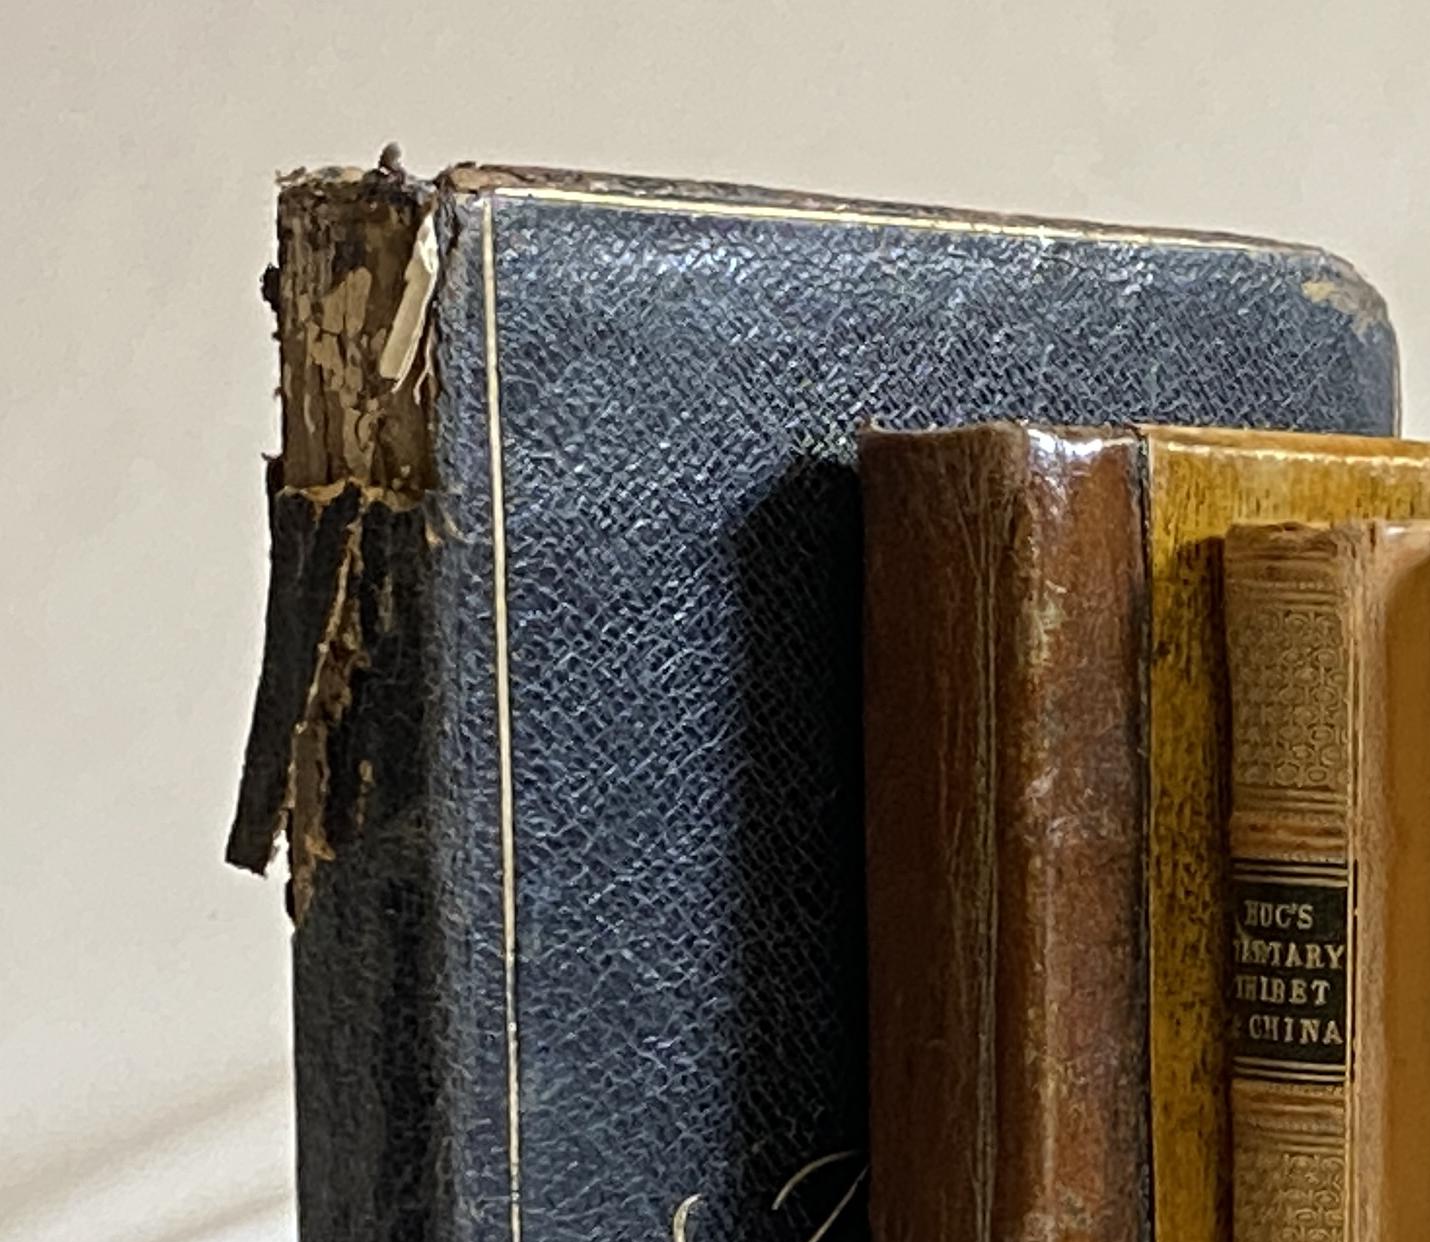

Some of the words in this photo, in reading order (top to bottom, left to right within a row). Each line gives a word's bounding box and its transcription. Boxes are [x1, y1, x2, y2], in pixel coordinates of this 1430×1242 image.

[1244, 900, 1314, 930] HUC'S
[1234, 974, 1331, 1006] THIBET
[1249, 1013, 1344, 1045] CHINA
